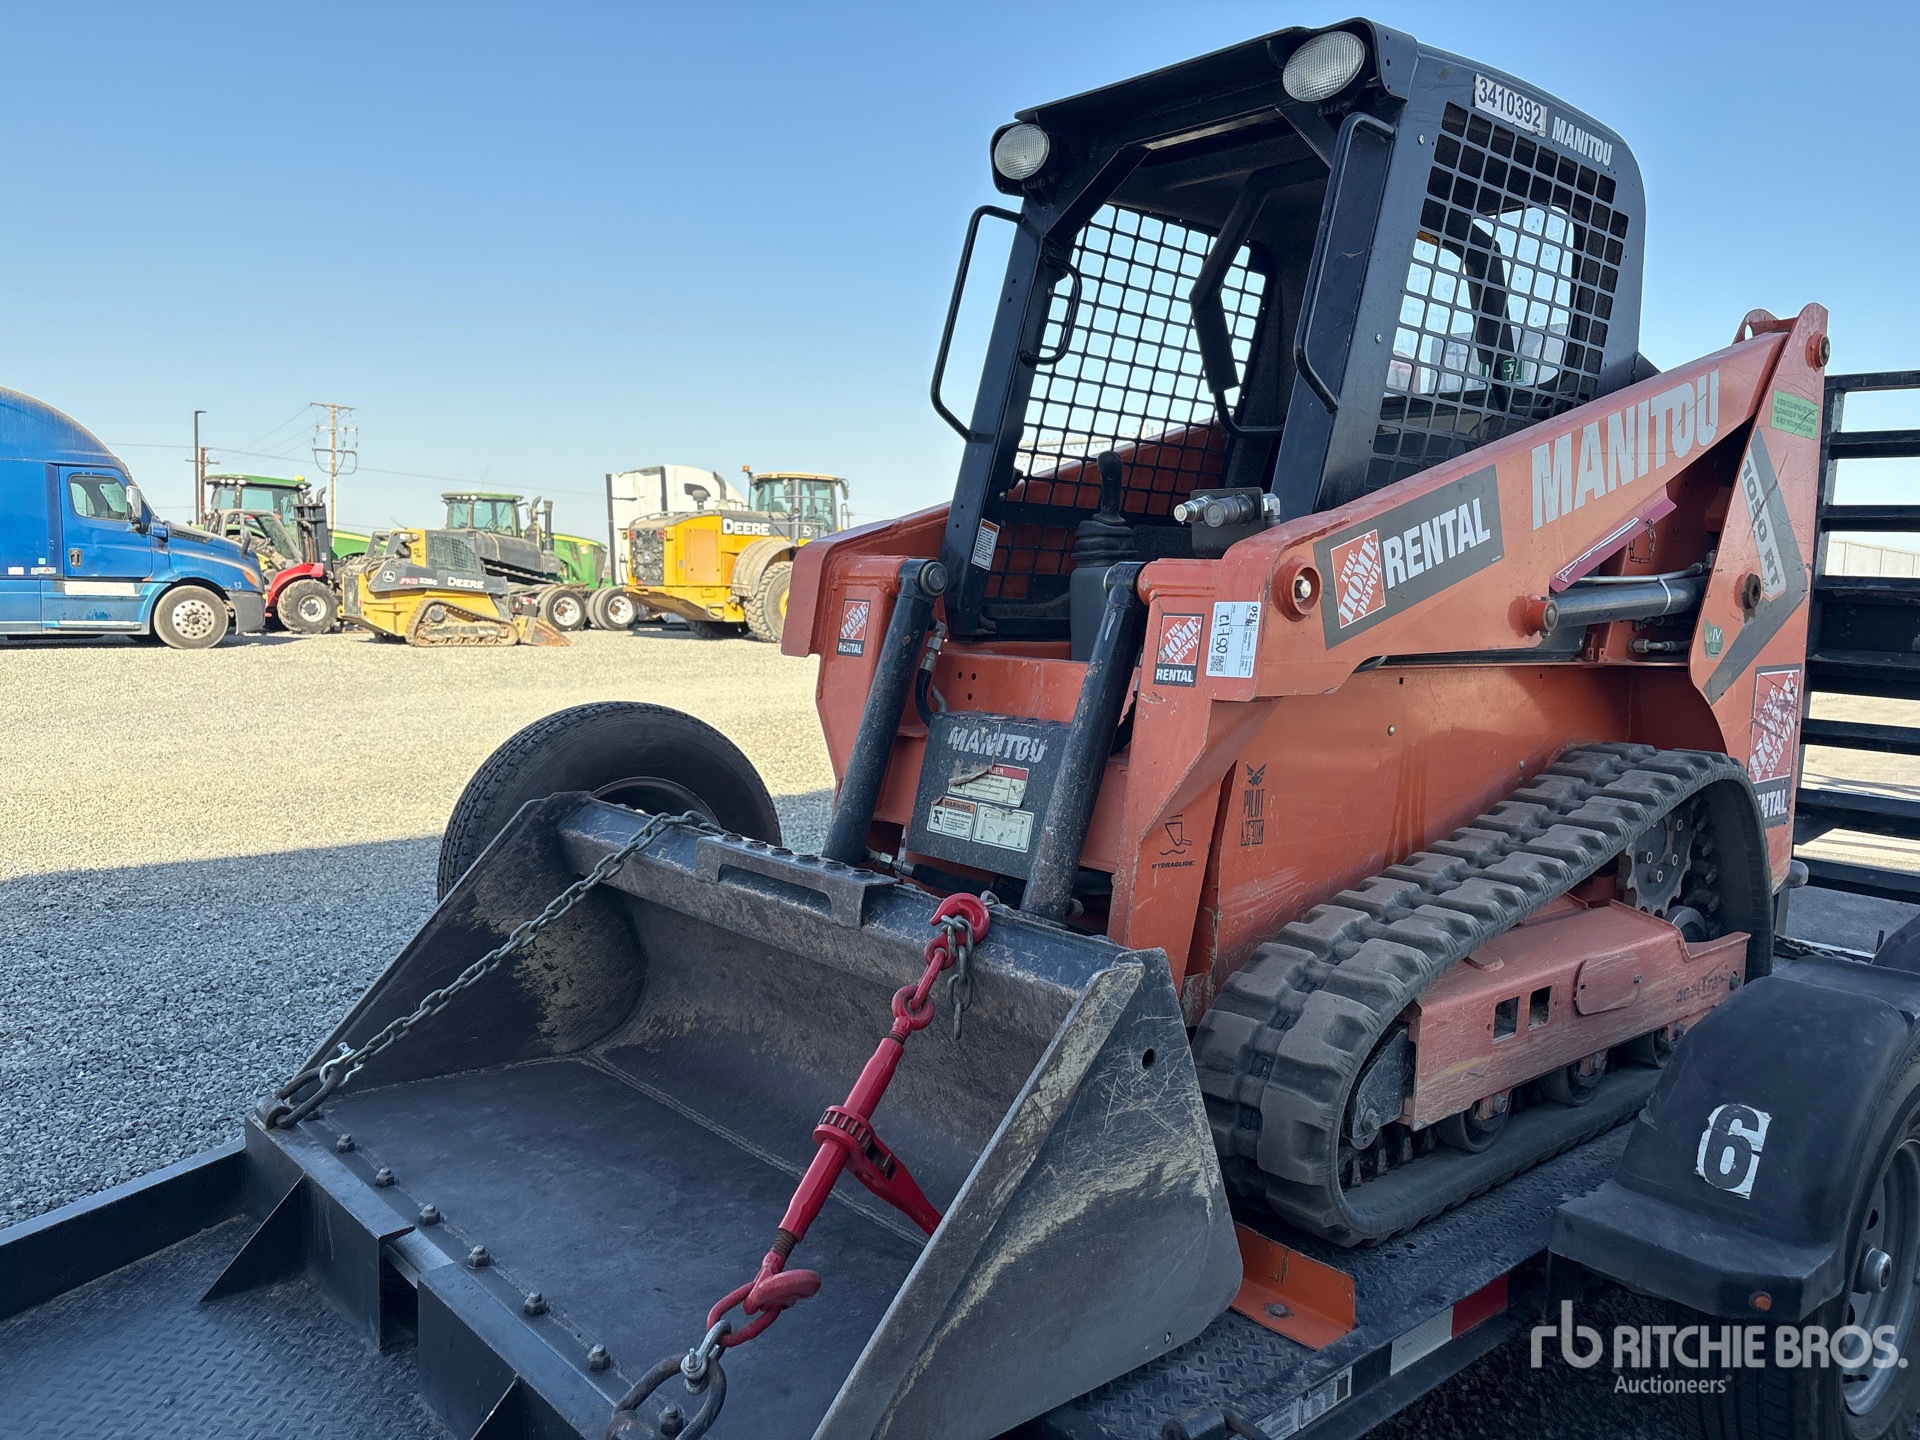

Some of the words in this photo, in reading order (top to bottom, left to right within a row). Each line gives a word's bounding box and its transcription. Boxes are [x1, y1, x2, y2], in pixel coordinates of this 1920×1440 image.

[1478, 78, 1542, 128] 3410392
[1551, 115, 1613, 166] MANITOU
[1531, 369, 1720, 531] MANITOU
[722, 518, 771, 536] DEERE
[1743, 460, 1768, 543] 1050
[1764, 547, 1780, 586] RT
[1384, 497, 1491, 590] RENTAL
[447, 576, 485, 590] DEERE
[1339, 549, 1358, 584] THE
[1339, 533, 1379, 623] HOME
[1358, 559, 1381, 616] DEPOT
[838, 641, 862, 654] RENTAL
[1165, 620, 1183, 641] THE
[1215, 613, 1230, 654] 051-12
[1172, 635, 1200, 664] DEPOT
[1155, 668, 1194, 683] RENTAL
[946, 726, 1046, 763] MANITOU
[988, 766, 1005, 776] GER
[944, 799, 971, 812] WARNING
[1243, 788, 1265, 818] PILOT
[1757, 789, 1787, 818] NTAL
[1703, 1103, 1760, 1190] 6
